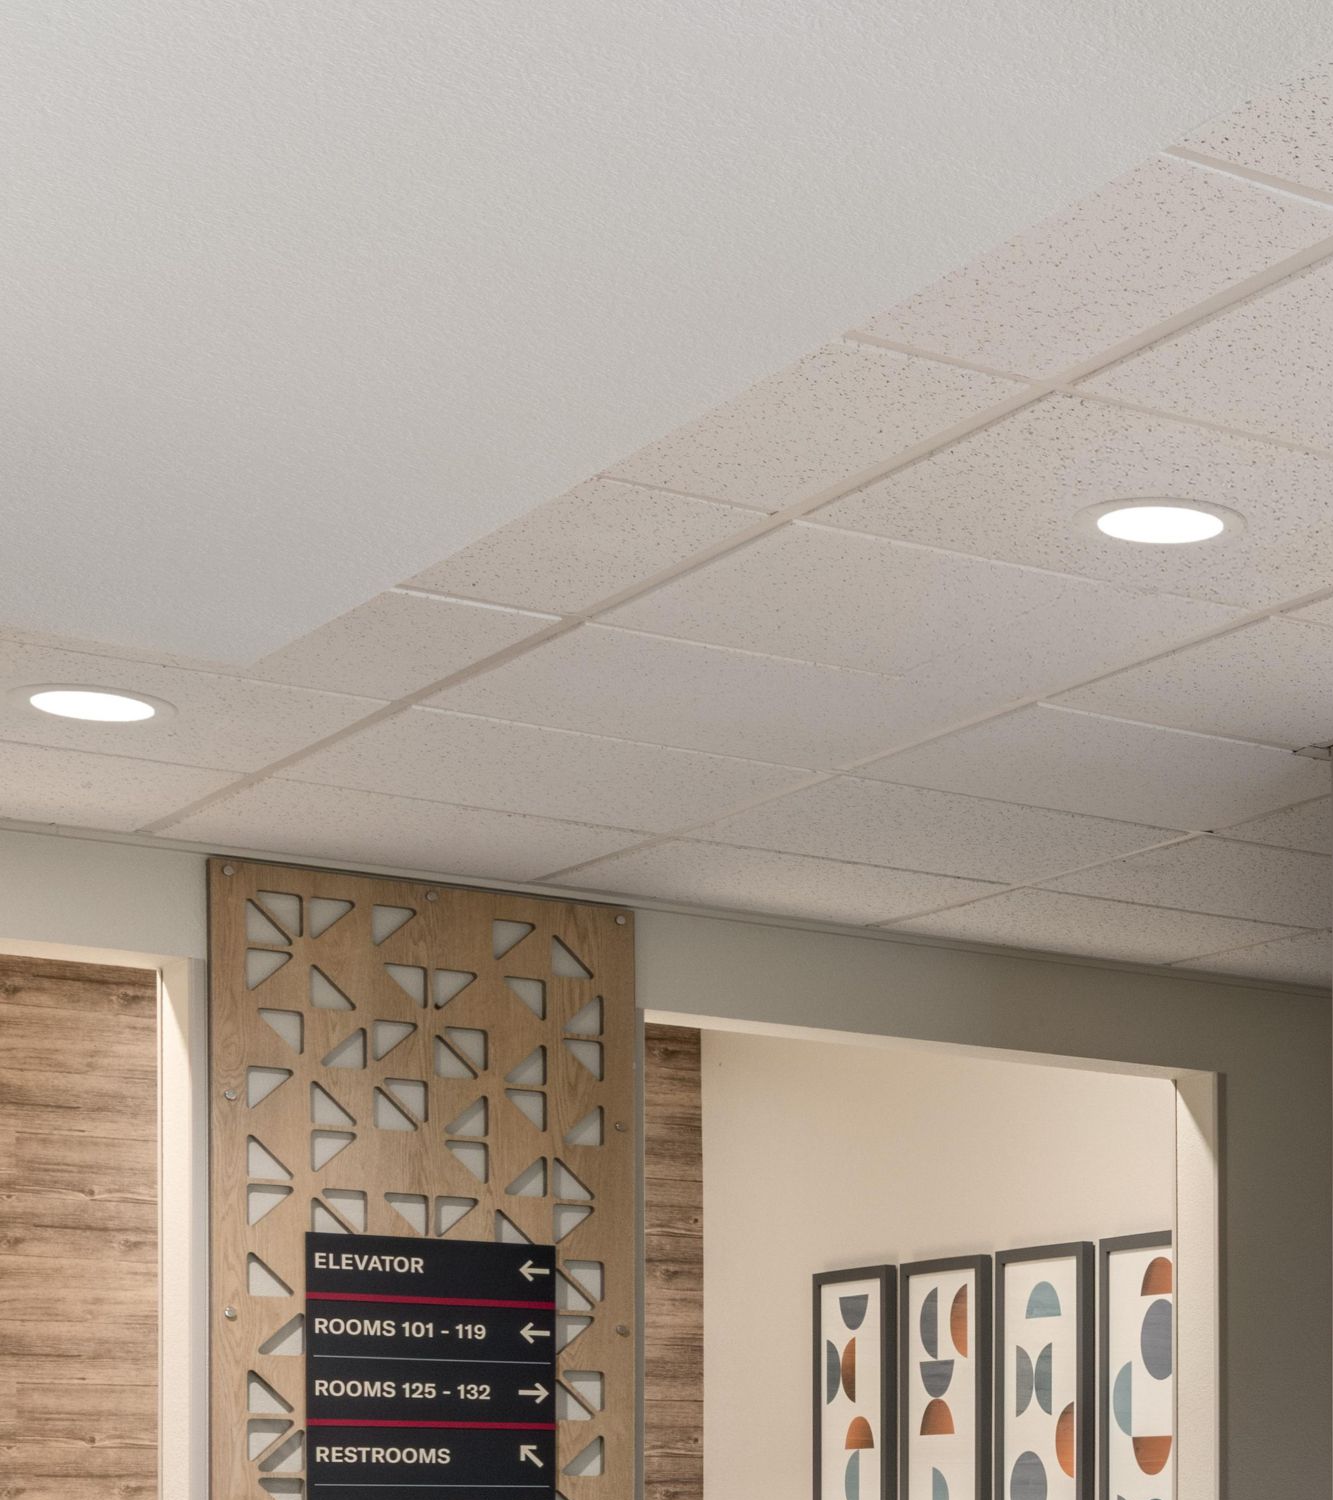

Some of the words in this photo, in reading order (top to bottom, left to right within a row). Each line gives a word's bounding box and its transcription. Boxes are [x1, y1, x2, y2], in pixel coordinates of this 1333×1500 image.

[314, 1251, 424, 1274] ELEVATOR
[314, 1317, 396, 1338] ROOMS
[401, 1321, 434, 1339] 101
[454, 1323, 487, 1340] 119
[314, 1379, 396, 1399] ROOMS
[401, 1382, 437, 1399] 125
[457, 1384, 491, 1400] 132
[315, 1446, 451, 1465] RESTROOMS
